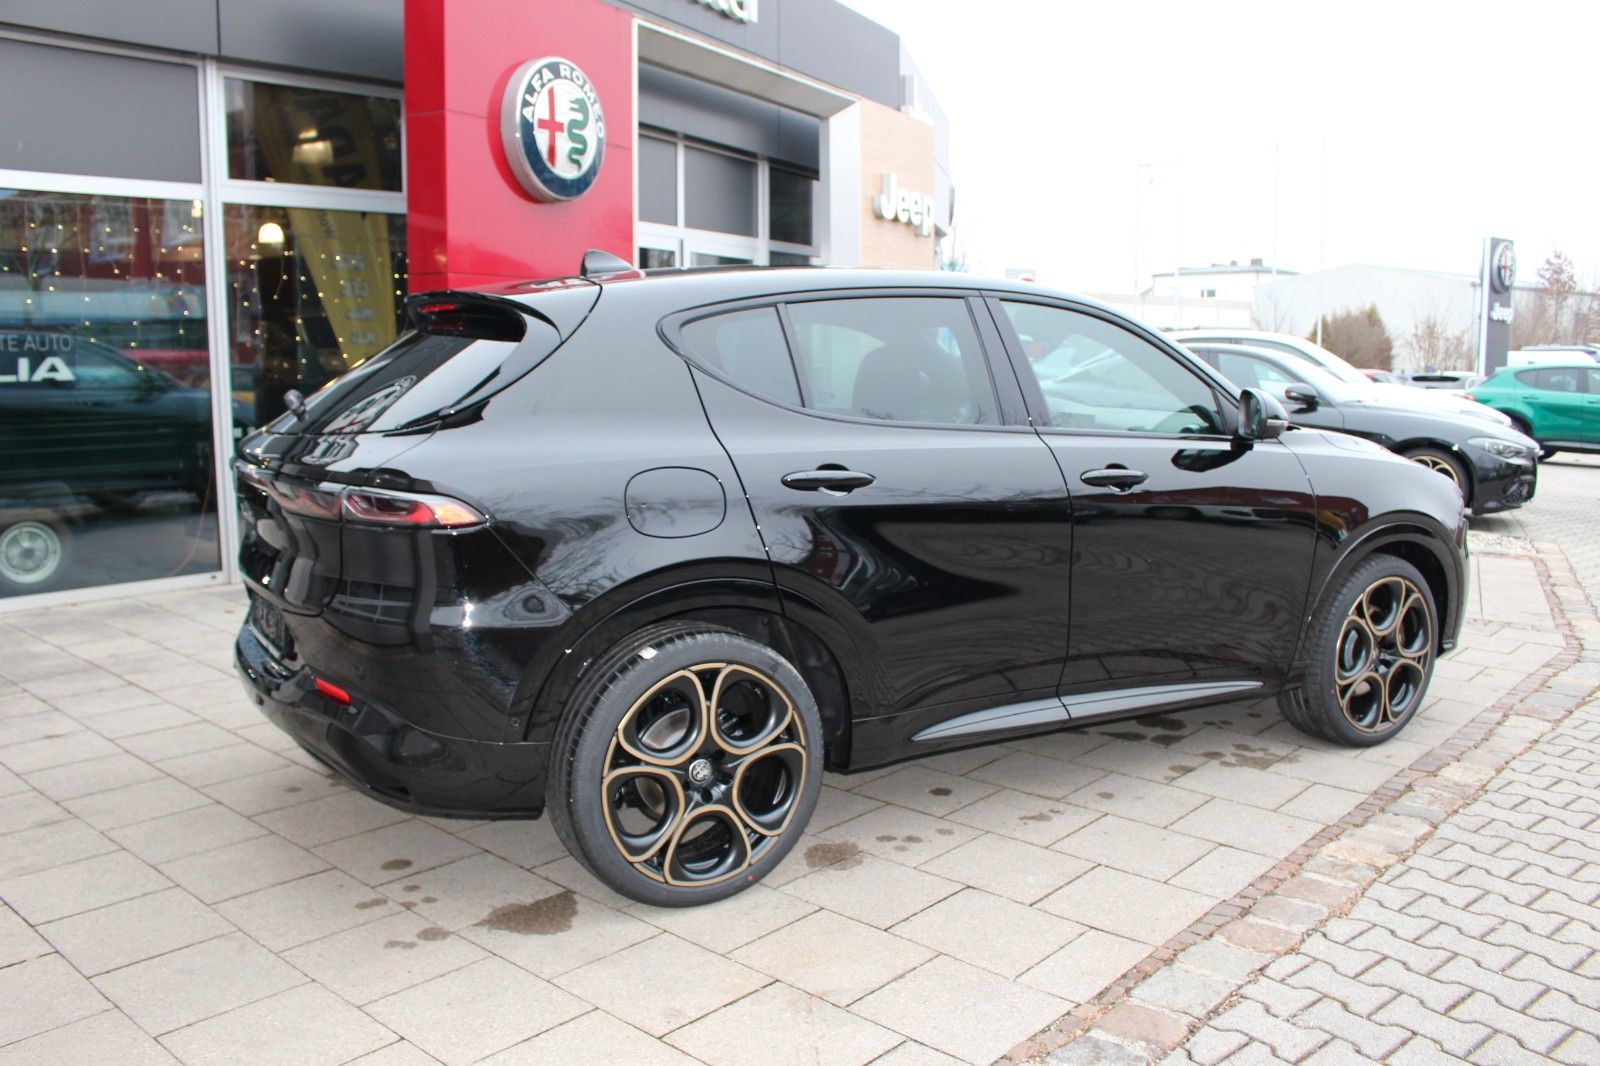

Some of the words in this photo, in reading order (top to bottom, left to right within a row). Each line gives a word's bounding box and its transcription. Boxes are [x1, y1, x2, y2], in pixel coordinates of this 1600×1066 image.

[521, 67, 555, 123] ALFA
[559, 63, 604, 138] ROMEO
[874, 170, 934, 236] Jeep
[24, 333, 72, 352] AUTO
